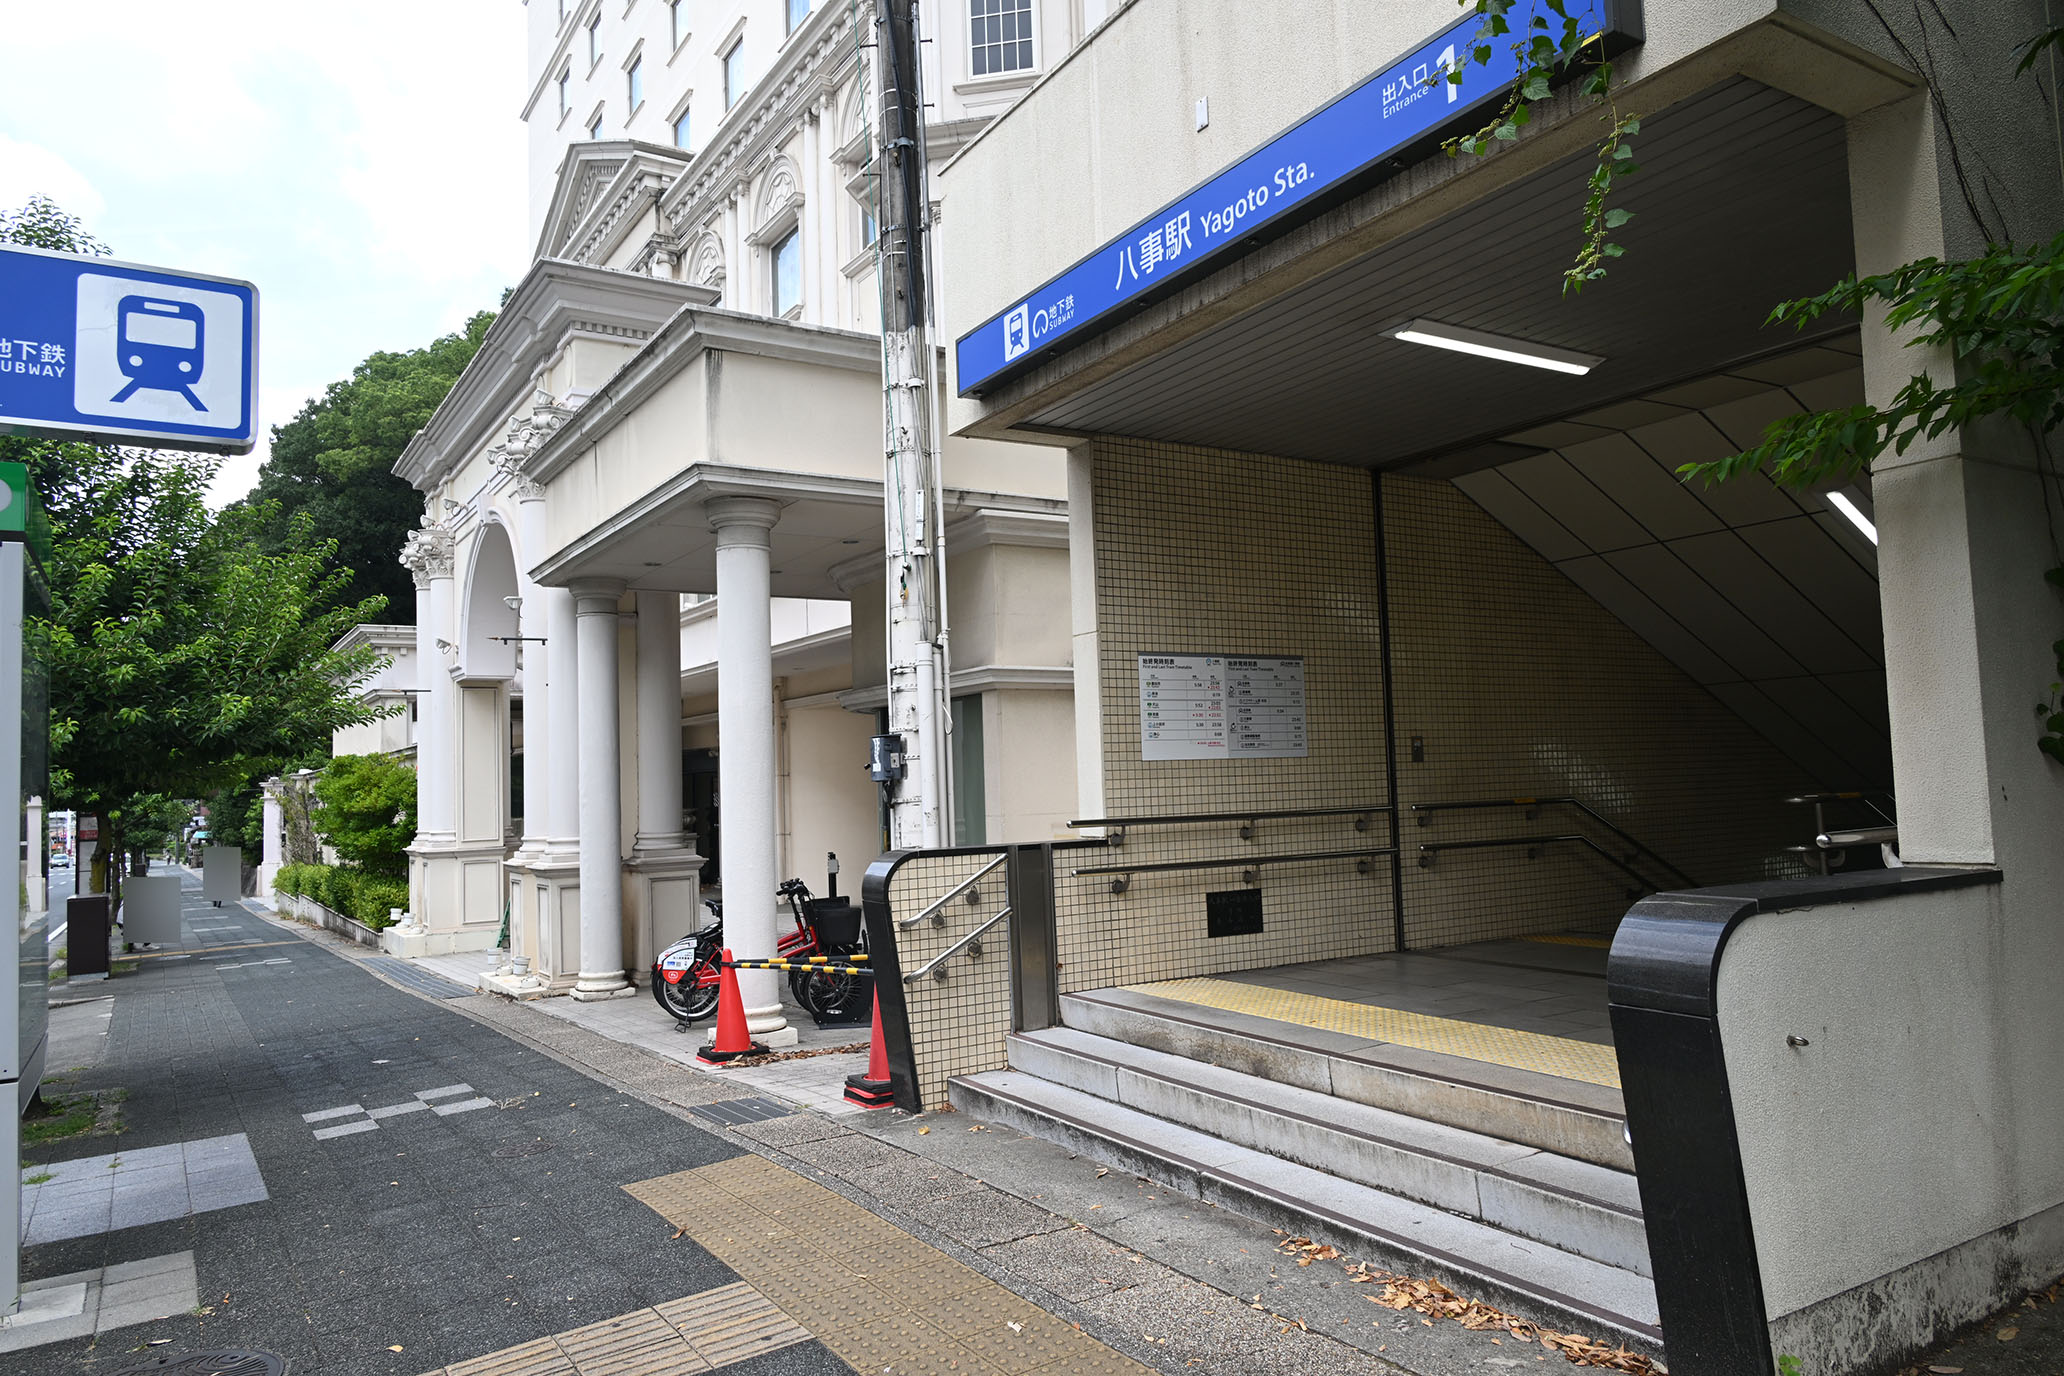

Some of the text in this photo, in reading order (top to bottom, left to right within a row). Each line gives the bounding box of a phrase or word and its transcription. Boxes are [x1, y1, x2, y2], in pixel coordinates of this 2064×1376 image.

[1382, 63, 1427, 106] 出入口
[1436, 43, 1458, 104] 1
[1383, 85, 1429, 119] Entrance
[1200, 161, 1315, 238] Yagoto Sta.
[1115, 210, 1192, 291] 八事駅
[1048, 293, 1075, 320] 地下鉄
[1049, 309, 1075, 330] SUBWAY
